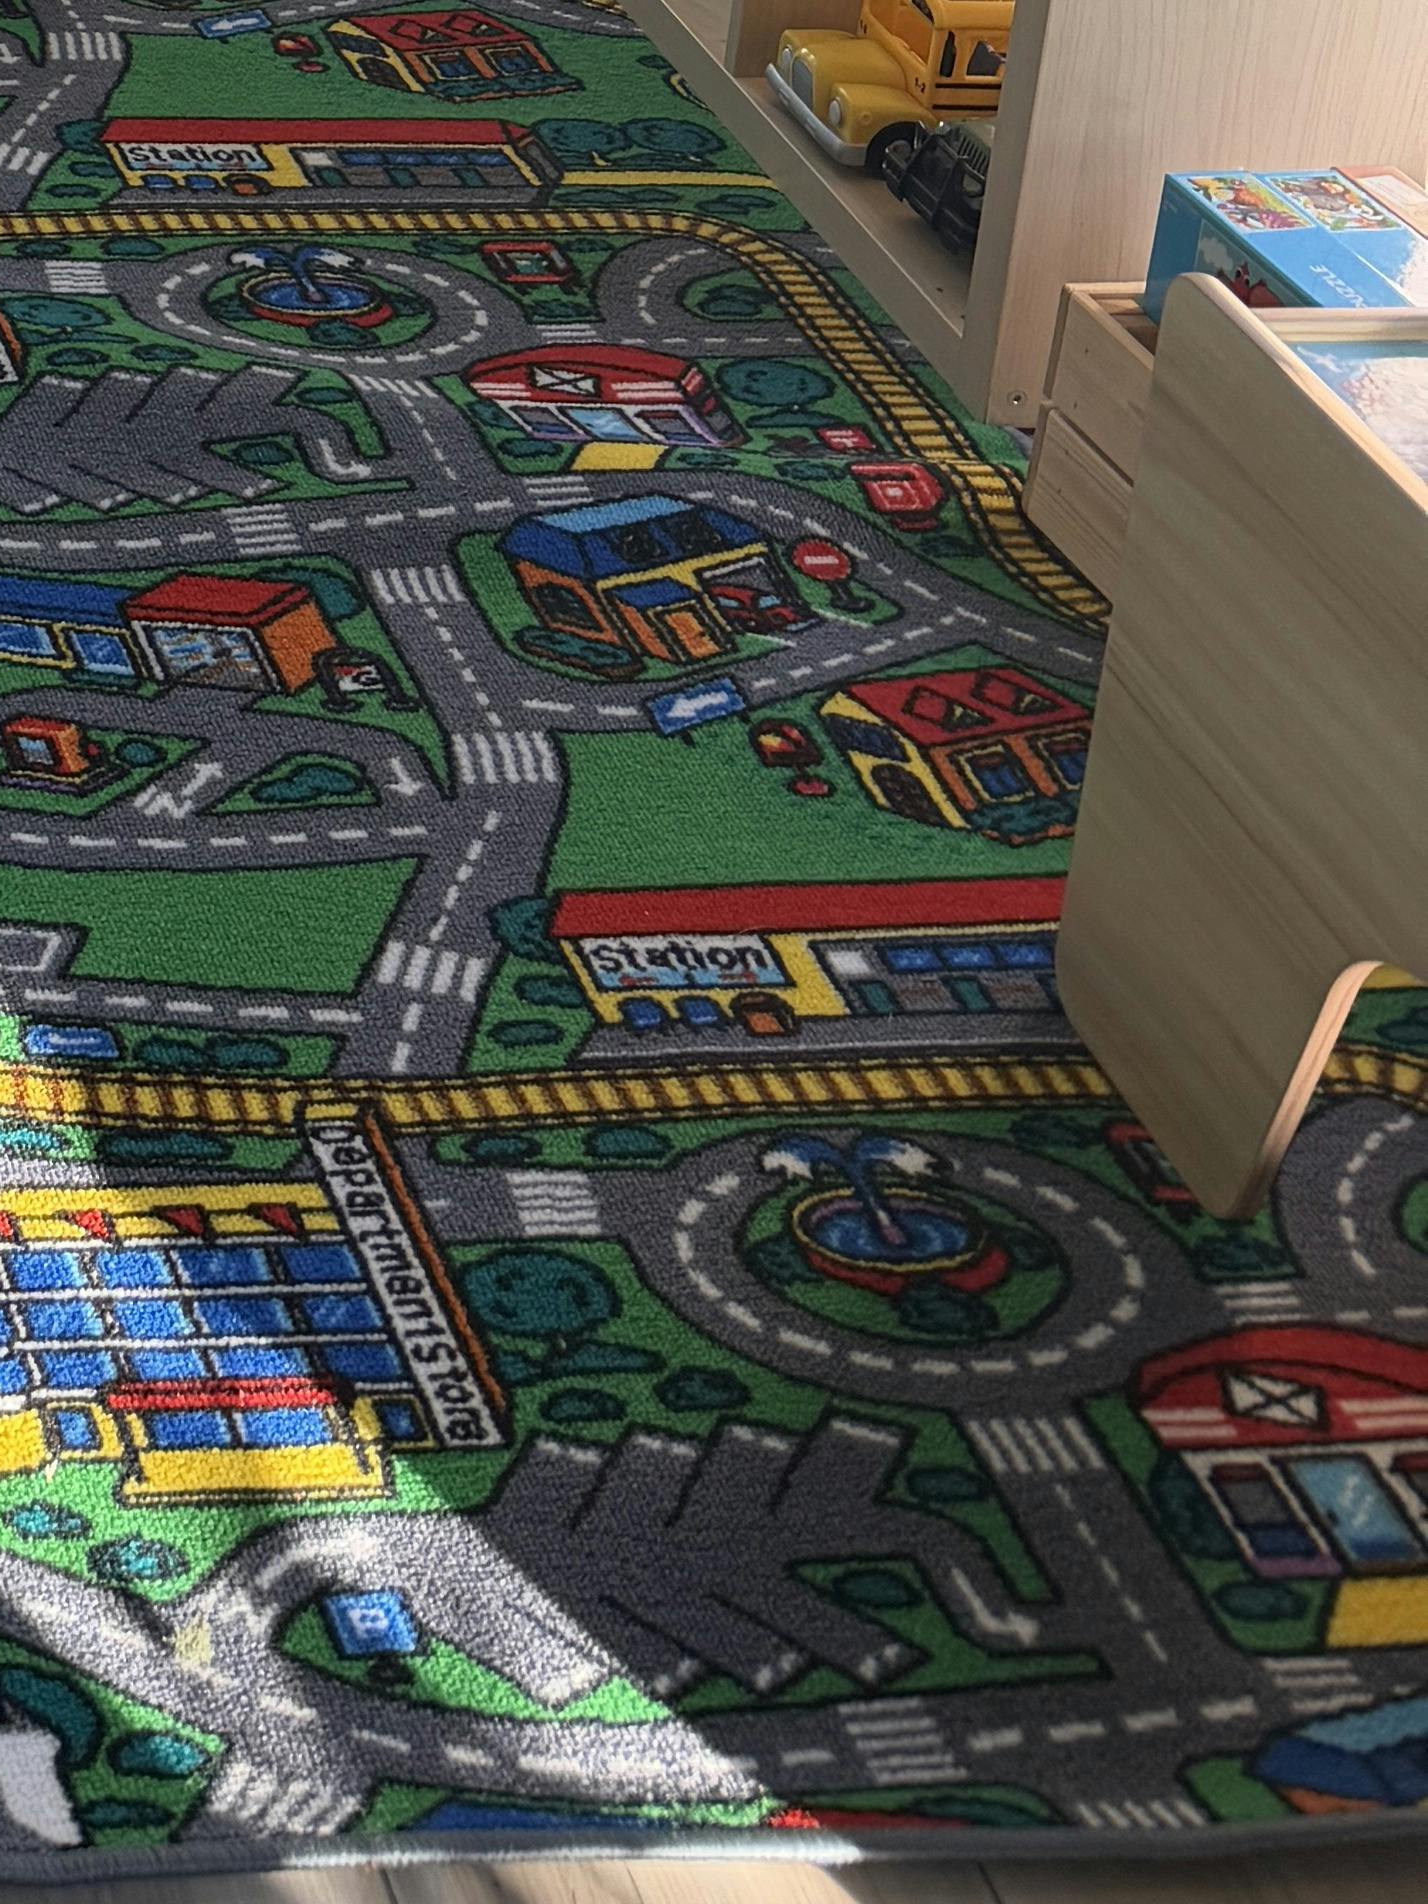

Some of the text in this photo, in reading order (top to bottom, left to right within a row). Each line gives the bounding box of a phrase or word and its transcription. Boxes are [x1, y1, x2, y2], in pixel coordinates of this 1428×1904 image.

[129, 145, 256, 163] Station
[1310, 263, 1369, 309] UZZLE
[590, 941, 766, 972] Station
